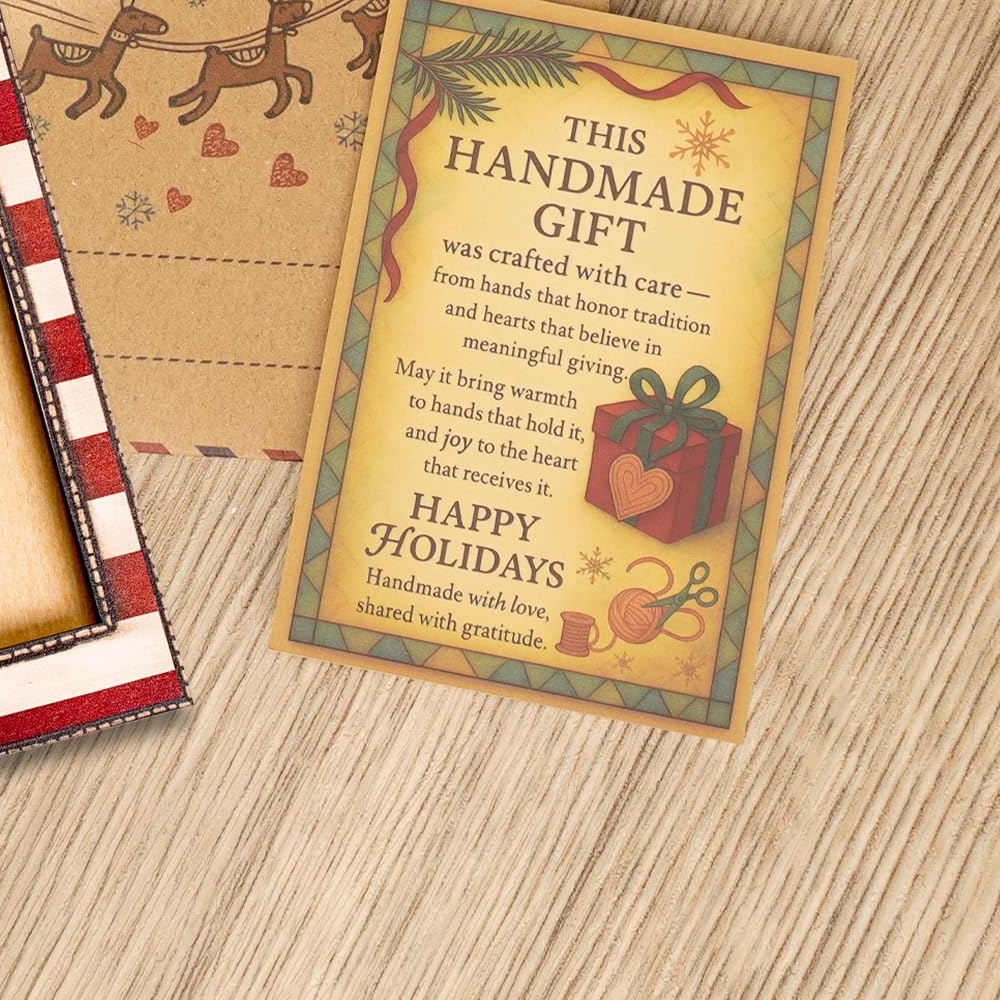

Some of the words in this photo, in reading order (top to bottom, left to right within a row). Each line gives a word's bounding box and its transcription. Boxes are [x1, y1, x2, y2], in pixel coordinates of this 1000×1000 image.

[563, 115, 647, 154] THIS
[444, 136, 745, 224] HANDMADE
[534, 203, 646, 253] GIFT
[443, 239, 482, 260] was
[489, 248, 568, 276] crafted
[576, 264, 627, 287] with
[432, 266, 474, 290] from
[481, 275, 531, 300] hands
[537, 288, 570, 308] that
[576, 292, 628, 319] honor
[633, 309, 711, 335] tradition
[445, 302, 477, 320] and
[483, 307, 535, 331] hearts
[541, 318, 573, 338] that
[579, 322, 639, 353] believe
[645, 339, 662, 356] in
[395, 357, 435, 386] May
[439, 366, 452, 383] it
[457, 373, 506, 399] bring
[511, 385, 578, 409] warmth
[463, 335, 562, 367] meaningful
[568, 353, 628, 381] giving.
[409, 394, 426, 409] to
[431, 395, 482, 421] hands
[488, 408, 521, 428] that
[527, 413, 564, 437] hold
[569, 425, 585, 443] it,
[405, 424, 438, 442] and
[440, 430, 473, 453] joy
[478, 438, 495, 454] to
[500, 442, 527, 459] the
[532, 446, 578, 471] heart
[423, 457, 458, 479] that
[463, 470, 532, 492] receives
[538, 481, 553, 498] it.
[410, 492, 541, 542] HAPPY
[365, 522, 565, 589] HOLIDAYS
[366, 567, 463, 602] Handmade
[469, 589, 507, 611] with
[511, 596, 549, 621] love,
[357, 596, 413, 623] shared
[419, 611, 457, 632] with
[461, 620, 547, 649] gratitude.
